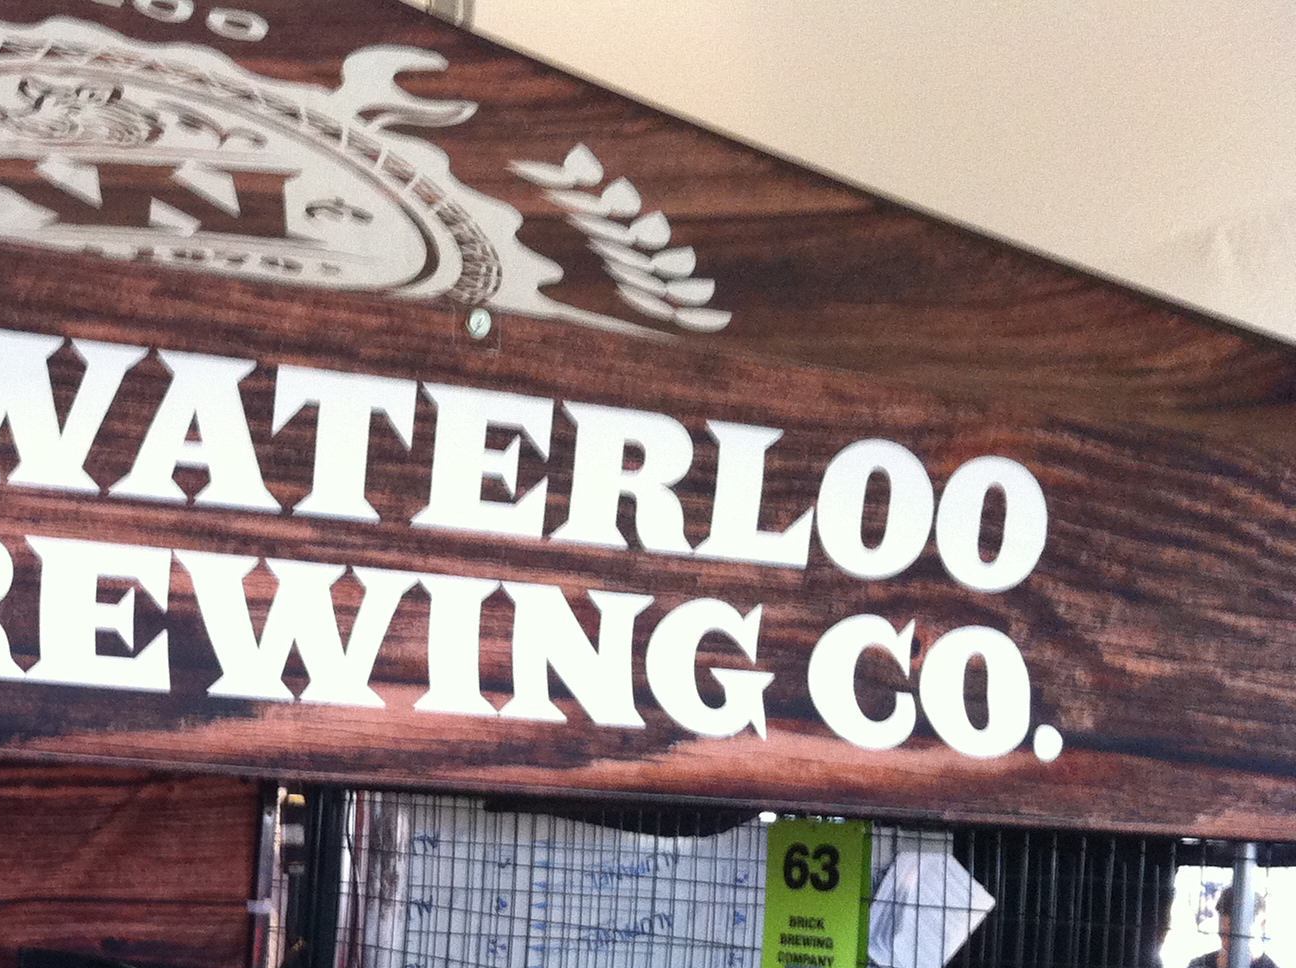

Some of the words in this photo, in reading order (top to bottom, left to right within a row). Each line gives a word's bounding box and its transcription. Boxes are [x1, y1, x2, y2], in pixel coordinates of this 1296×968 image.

[807, 613, 1064, 763] CO.
[783, 843, 841, 891] 63
[788, 915, 826, 931] BRICK
[779, 933, 835, 950] BREWING
[777, 951, 836, 968] COMPANY
